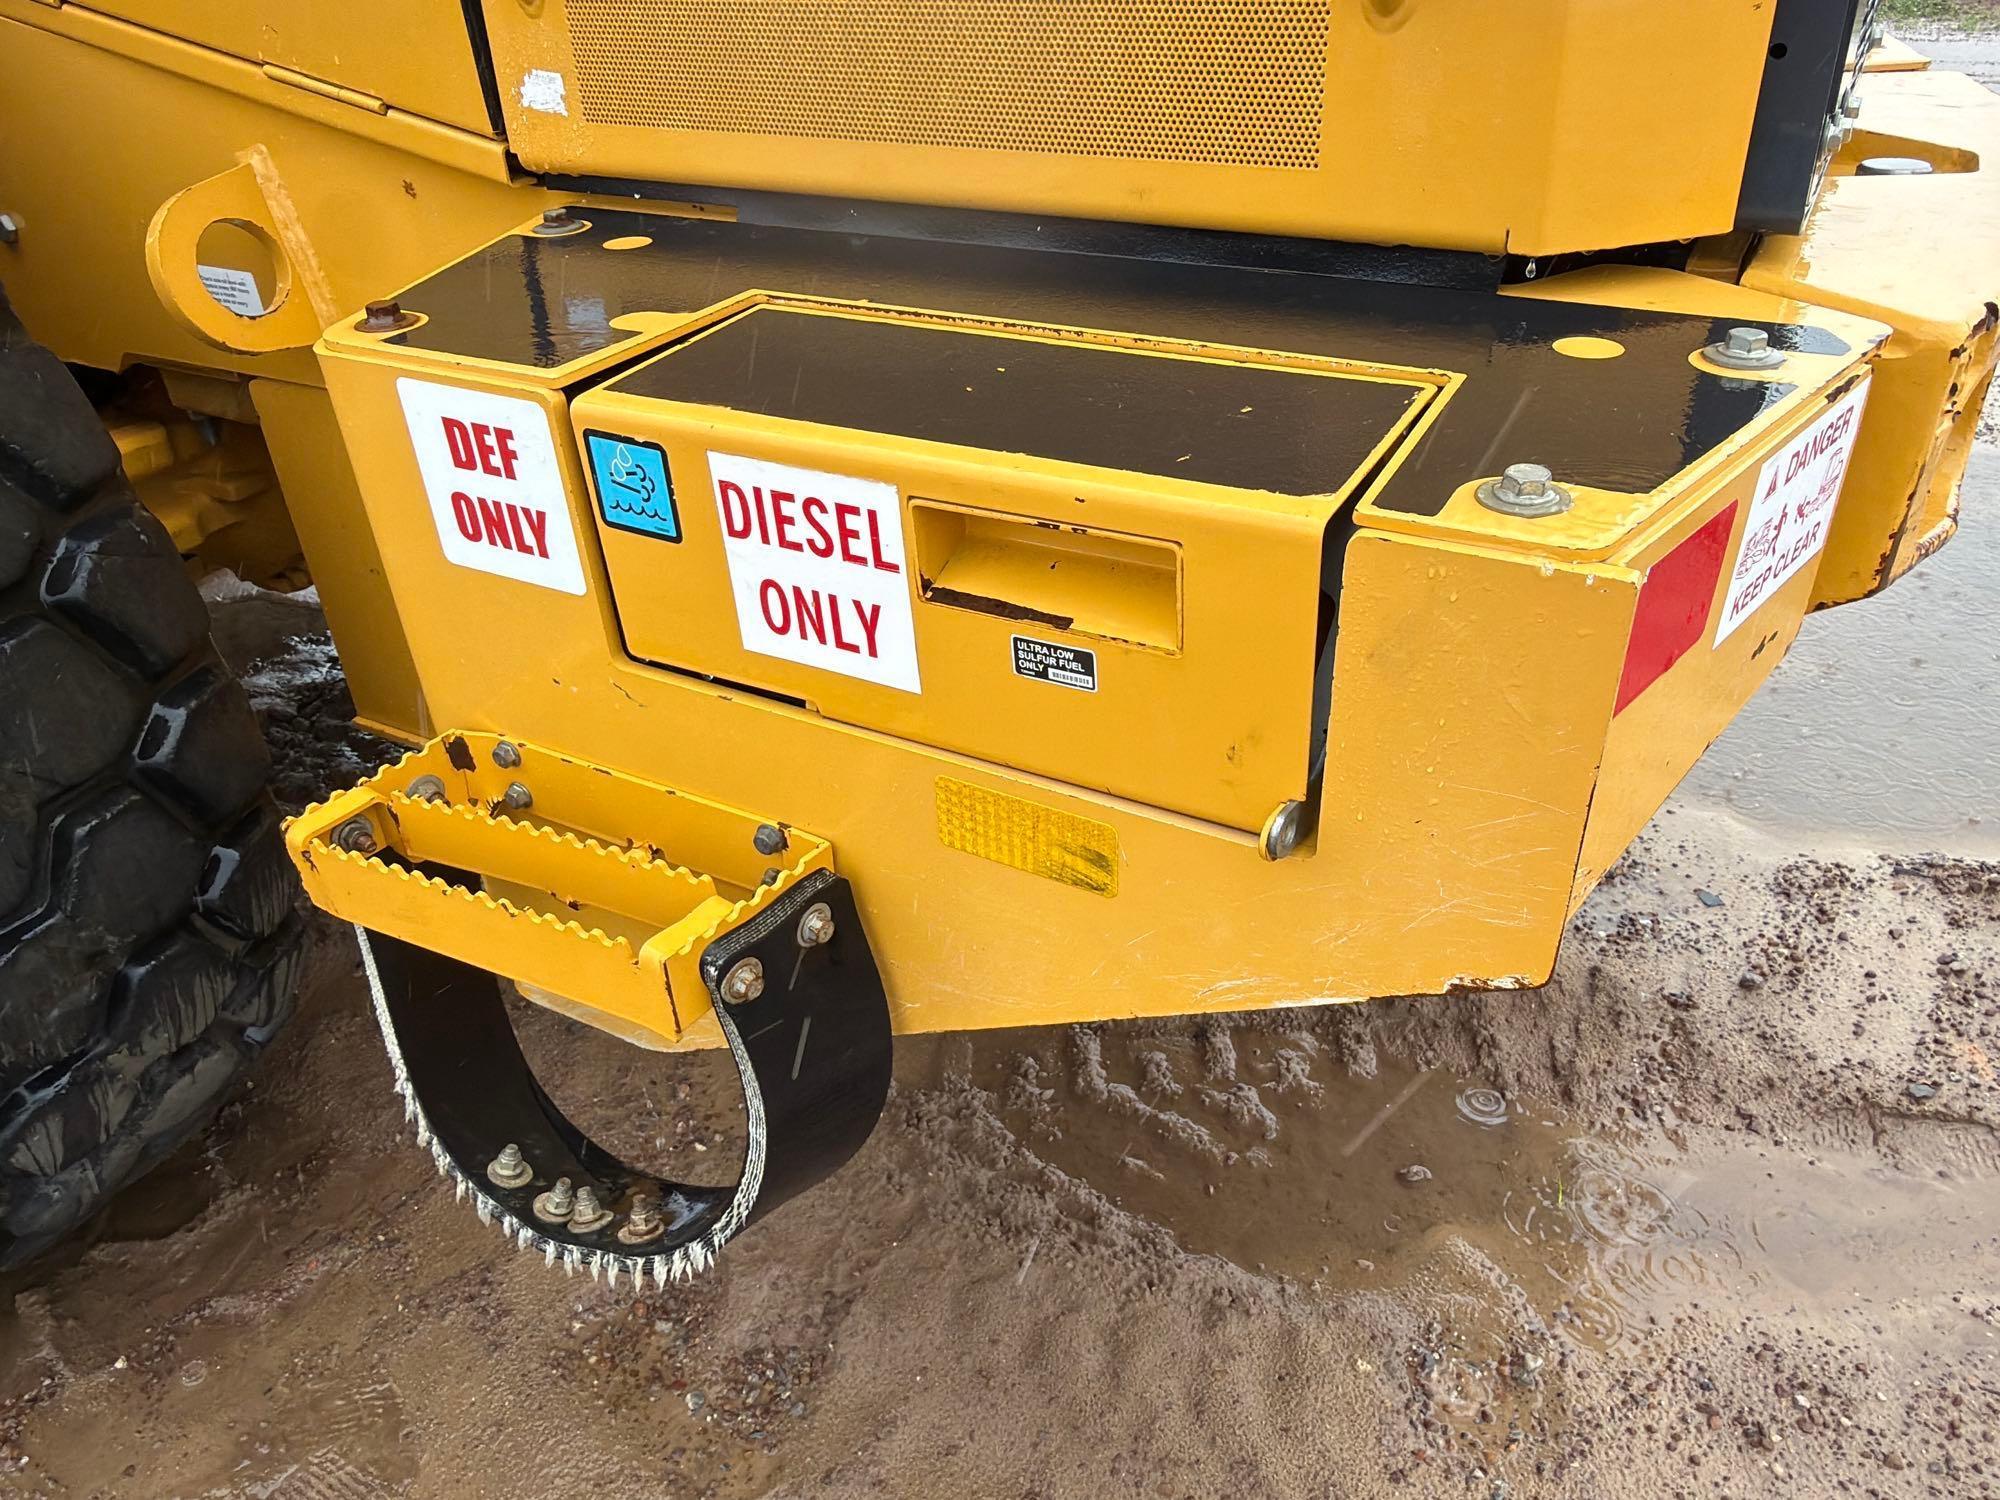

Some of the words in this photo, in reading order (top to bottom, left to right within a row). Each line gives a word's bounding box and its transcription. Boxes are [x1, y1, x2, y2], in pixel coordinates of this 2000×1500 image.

[441, 416, 518, 480] DEF
[1784, 405, 1854, 486] DANGER
[451, 491, 549, 559] ONLY
[719, 480, 900, 574] DIESEL
[1730, 568, 1772, 621] KEEP
[1772, 521, 1821, 580] CLEAR
[760, 579, 881, 658] ONLY
[1017, 641, 1049, 655] ULTRA
[1051, 648, 1074, 660] LOW
[1018, 650, 1057, 666] SULFUR
[1058, 659, 1085, 672] FUEL
[1019, 660, 1044, 672] ONLY
